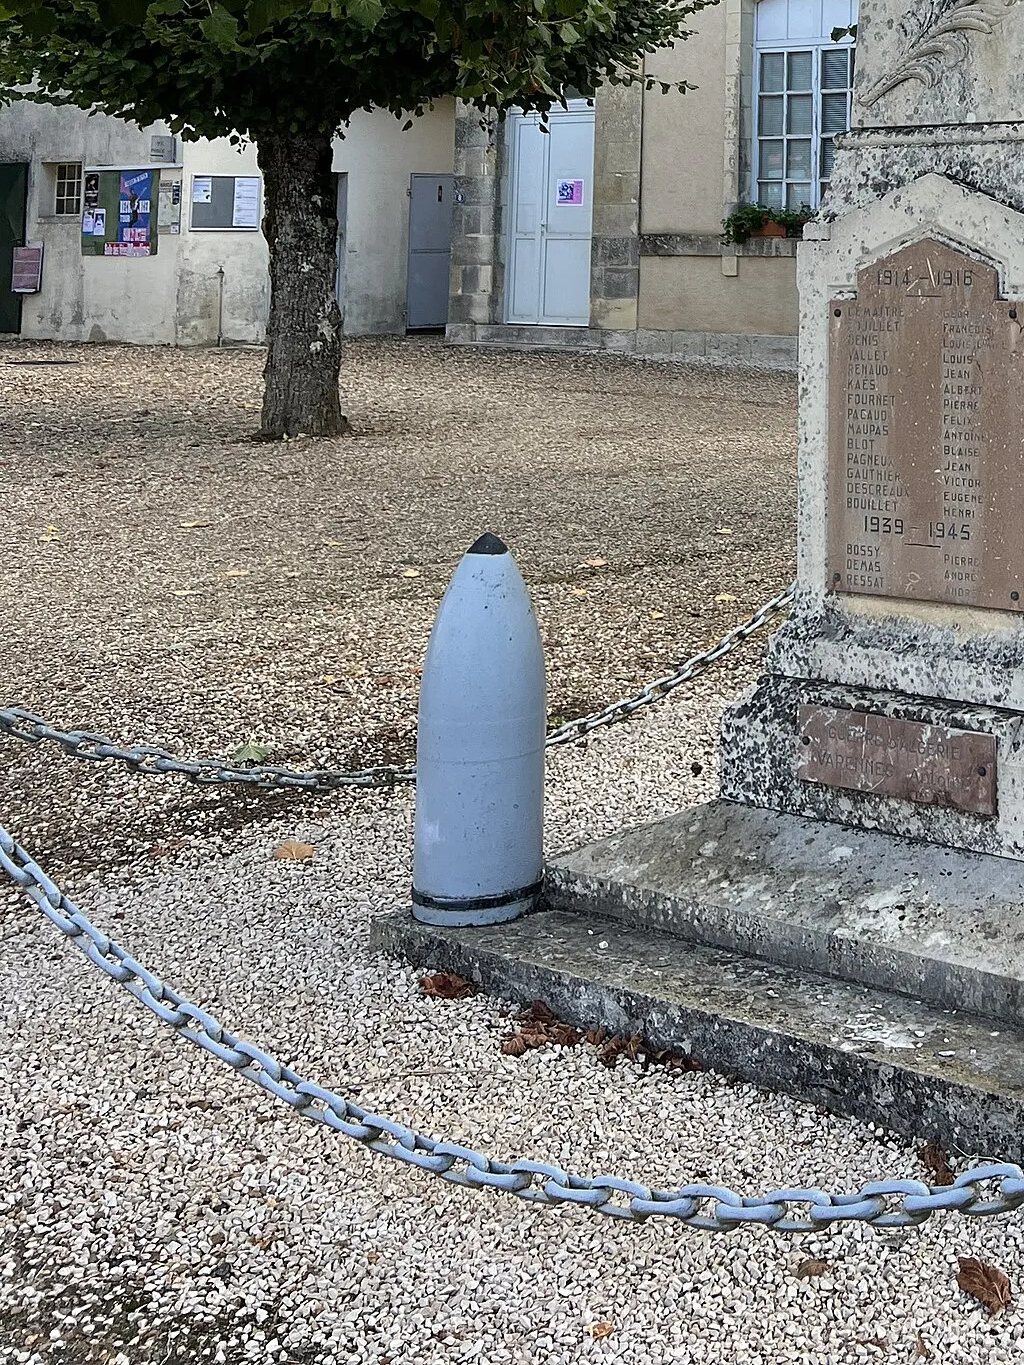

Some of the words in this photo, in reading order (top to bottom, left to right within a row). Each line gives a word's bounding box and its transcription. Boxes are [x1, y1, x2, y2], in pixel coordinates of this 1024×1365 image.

[877, 269, 911, 286] 1914
[848, 335, 879, 346] DENIS
[848, 350, 888, 362] VALLET
[943, 353, 973, 365] LOUIS
[943, 369, 971, 380] JEAN
[943, 385, 983, 396] ALBERT
[847, 393, 896, 407] FOURNET
[943, 399, 979, 411] PIERRE
[943, 414, 973, 427] FELIX
[847, 423, 889, 437] MAUPAS
[847, 438, 875, 451] BLOT
[943, 445, 980, 458] BLAISE
[847, 453, 895, 468] PAGNEUX
[943, 461, 972, 473] JEAN
[847, 468, 901, 483] GAUTHIER
[943, 475, 981, 488] VICTOR
[847, 482, 910, 498] DESCREAUX
[847, 497, 899, 512] BOUILLET
[943, 507, 976, 520] HENRI
[864, 515, 904, 535] 1939
[929, 521, 971, 541] 1945
[847, 544, 881, 558] BOSSY
[943, 553, 980, 568] PIERRE
[847, 559, 882, 573] DEMAS
[847, 574, 885, 589] RESSAT
[816, 749, 894, 778] VARENNES
